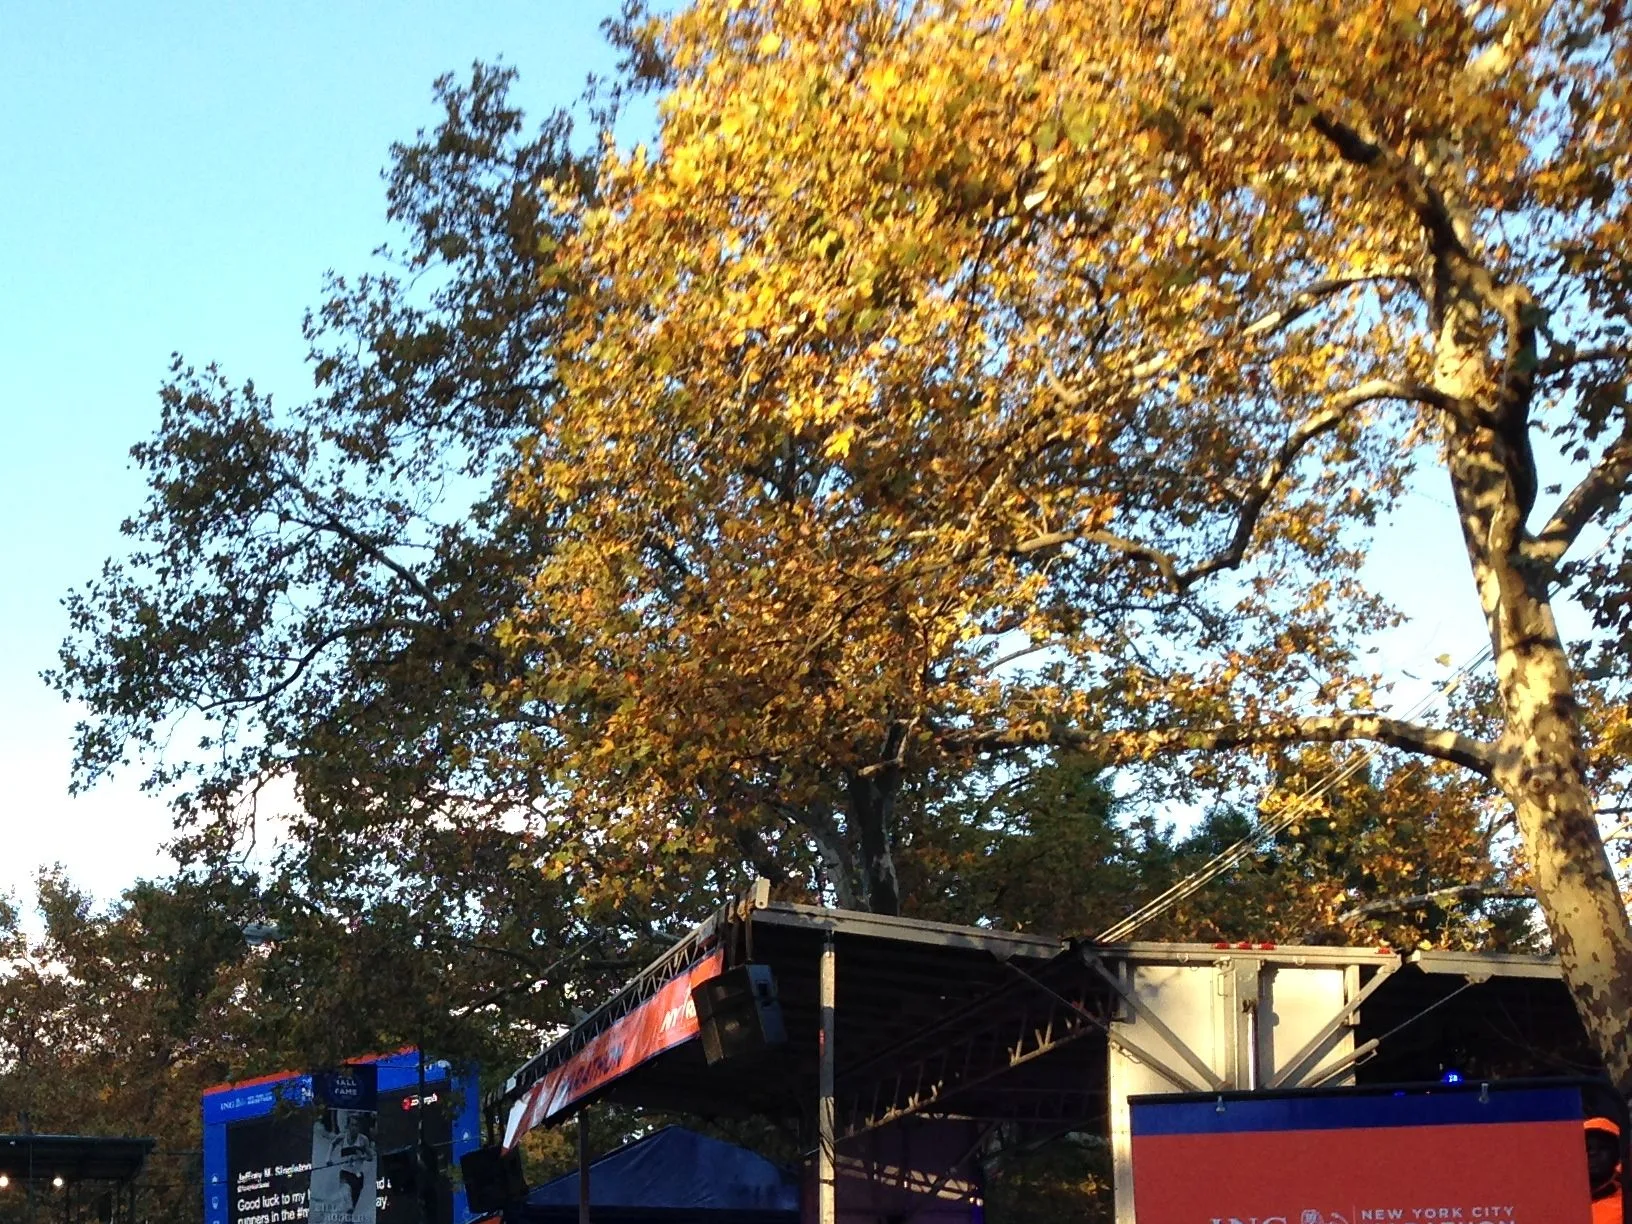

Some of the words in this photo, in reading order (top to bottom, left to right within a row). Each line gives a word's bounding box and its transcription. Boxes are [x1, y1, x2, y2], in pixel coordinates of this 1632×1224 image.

[238, 1197, 260, 1211] Good
[262, 1193, 280, 1208] luck
[282, 1193, 291, 1205] to
[292, 1192, 306, 1205] my
[271, 1210, 280, 1223] in
[281, 1208, 295, 1221] the
[1361, 1208, 1403, 1221] NEW
[1412, 1207, 1463, 1220] YORK
[1471, 1205, 1515, 1218] CITY
